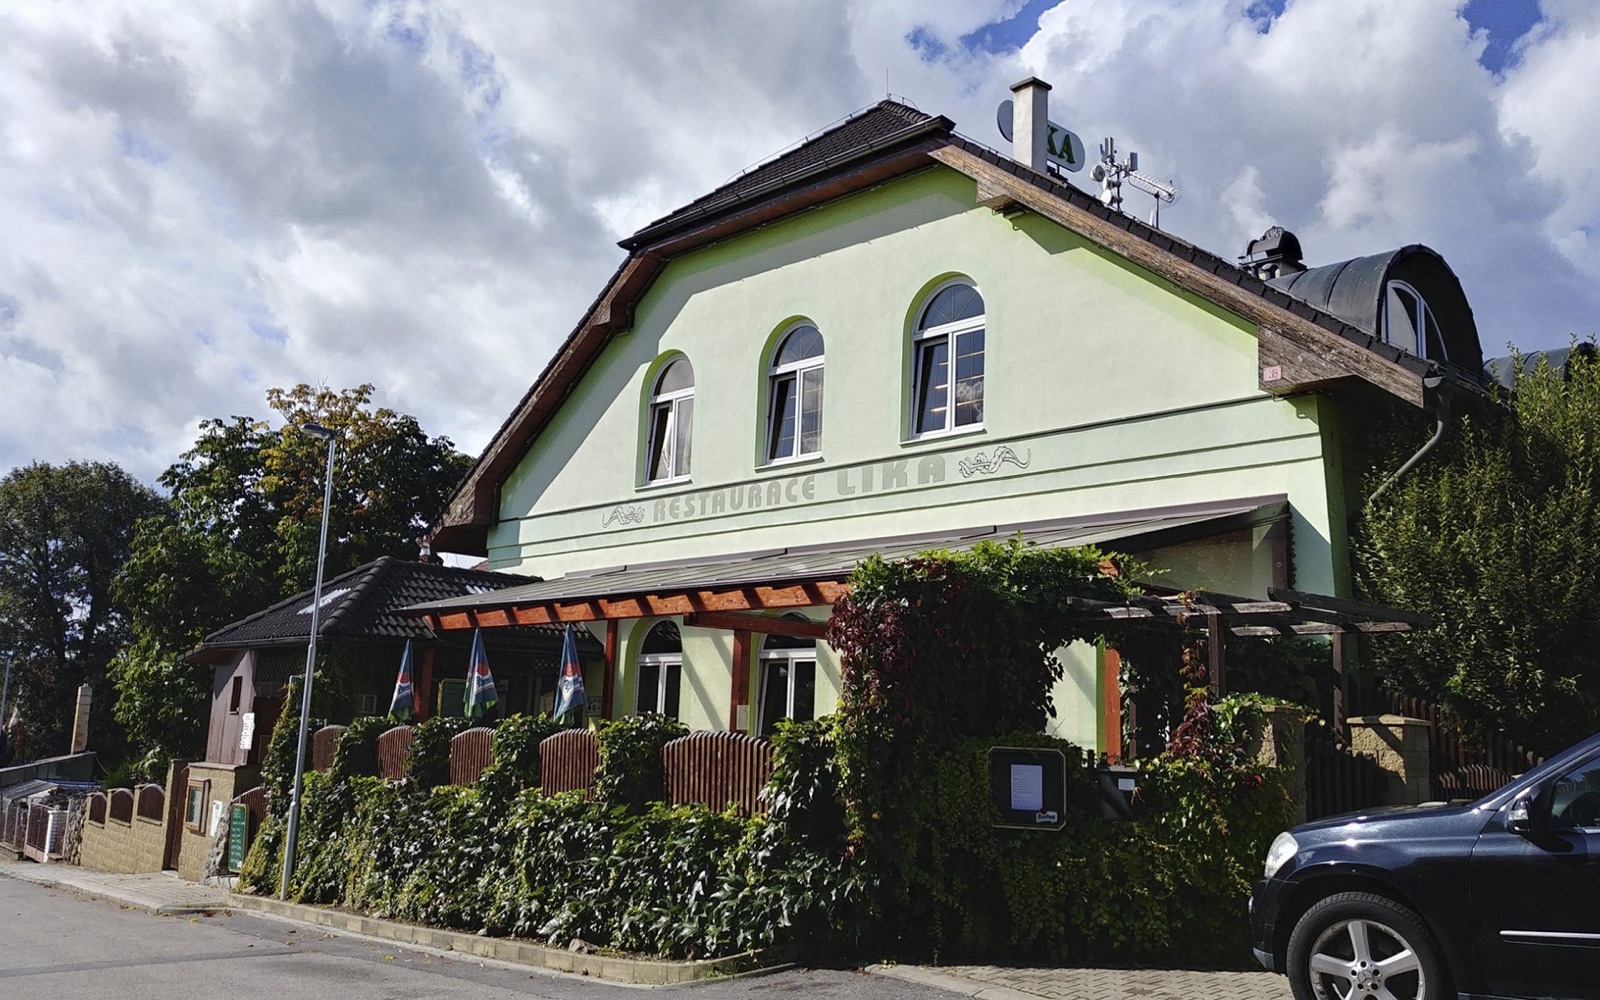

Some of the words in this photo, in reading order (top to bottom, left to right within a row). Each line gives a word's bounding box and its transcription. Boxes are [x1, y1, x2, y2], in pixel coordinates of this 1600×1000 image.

[1047, 124, 1076, 164] KA
[653, 475, 815, 522] RESTAURACE
[837, 454, 946, 495] LIKA
